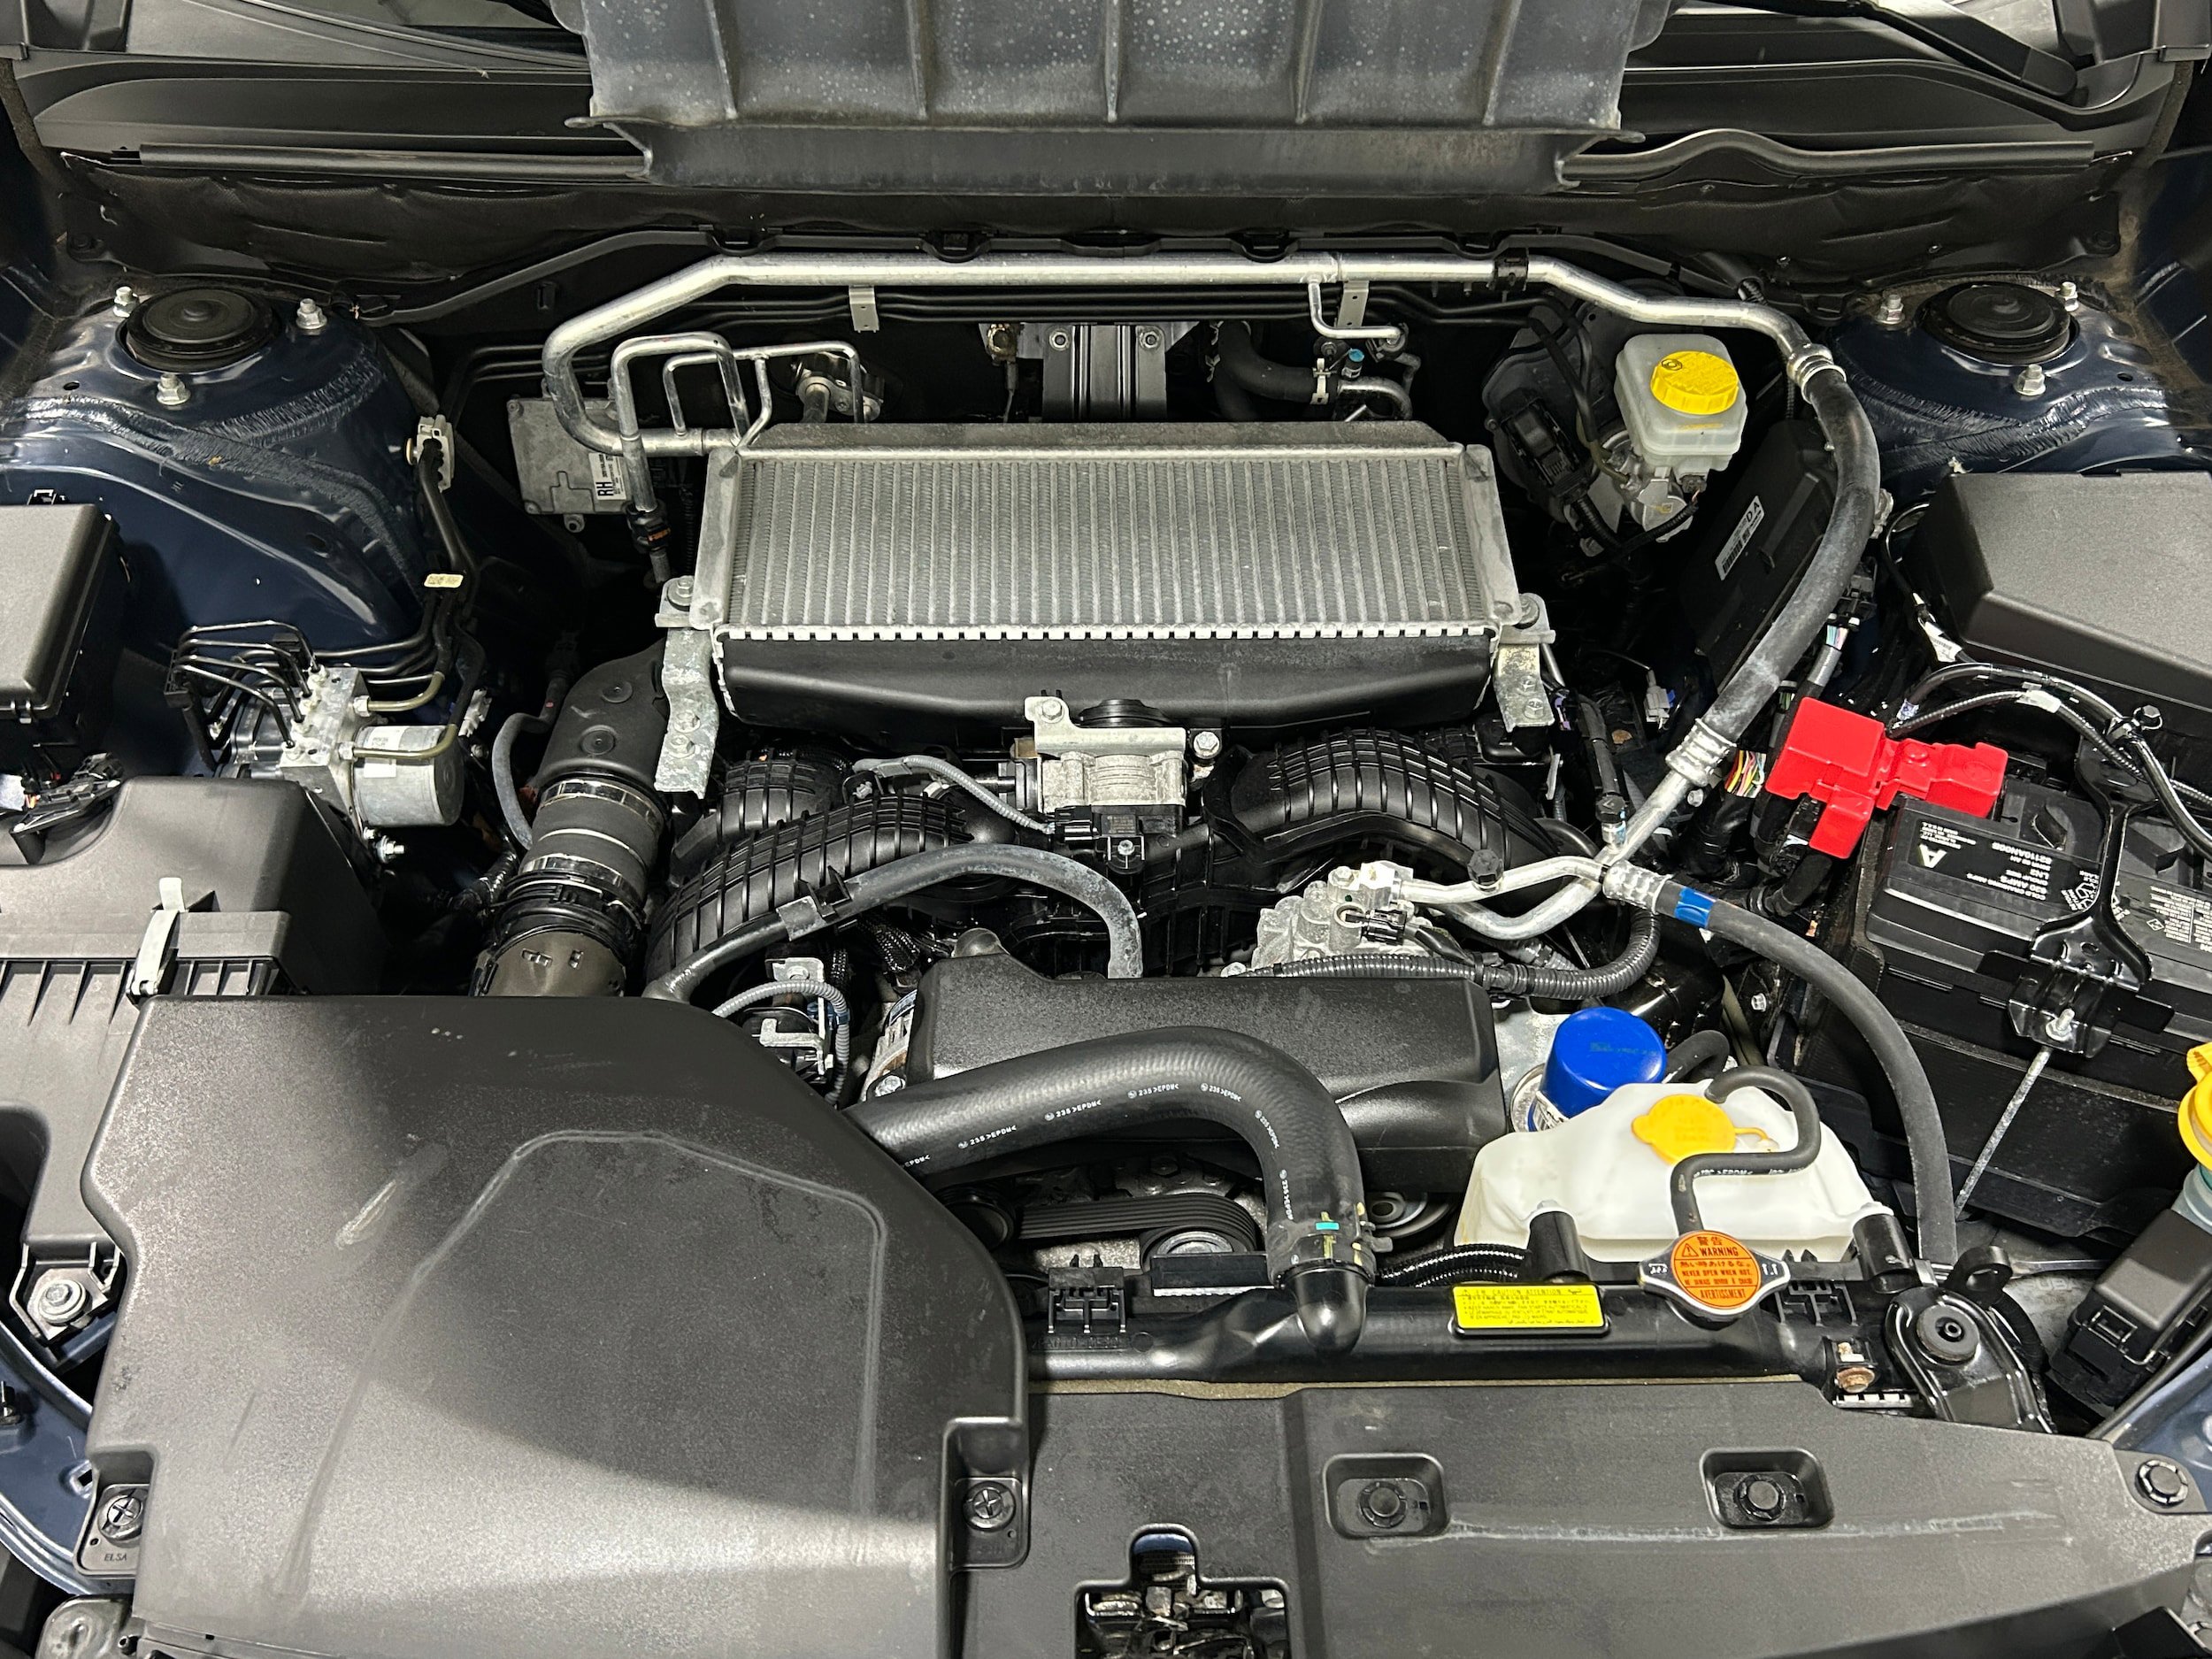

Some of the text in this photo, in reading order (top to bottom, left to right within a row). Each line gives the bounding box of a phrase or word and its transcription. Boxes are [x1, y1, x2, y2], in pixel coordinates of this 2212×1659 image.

[595, 482, 614, 495] RH
[1919, 843, 1947, 869] A
[1987, 879, 2025, 895] CRANKING
[2000, 875, 2029, 889] AMPS
[2025, 890, 2047, 901] COLD
[1700, 1247, 1739, 1256] WARNING
